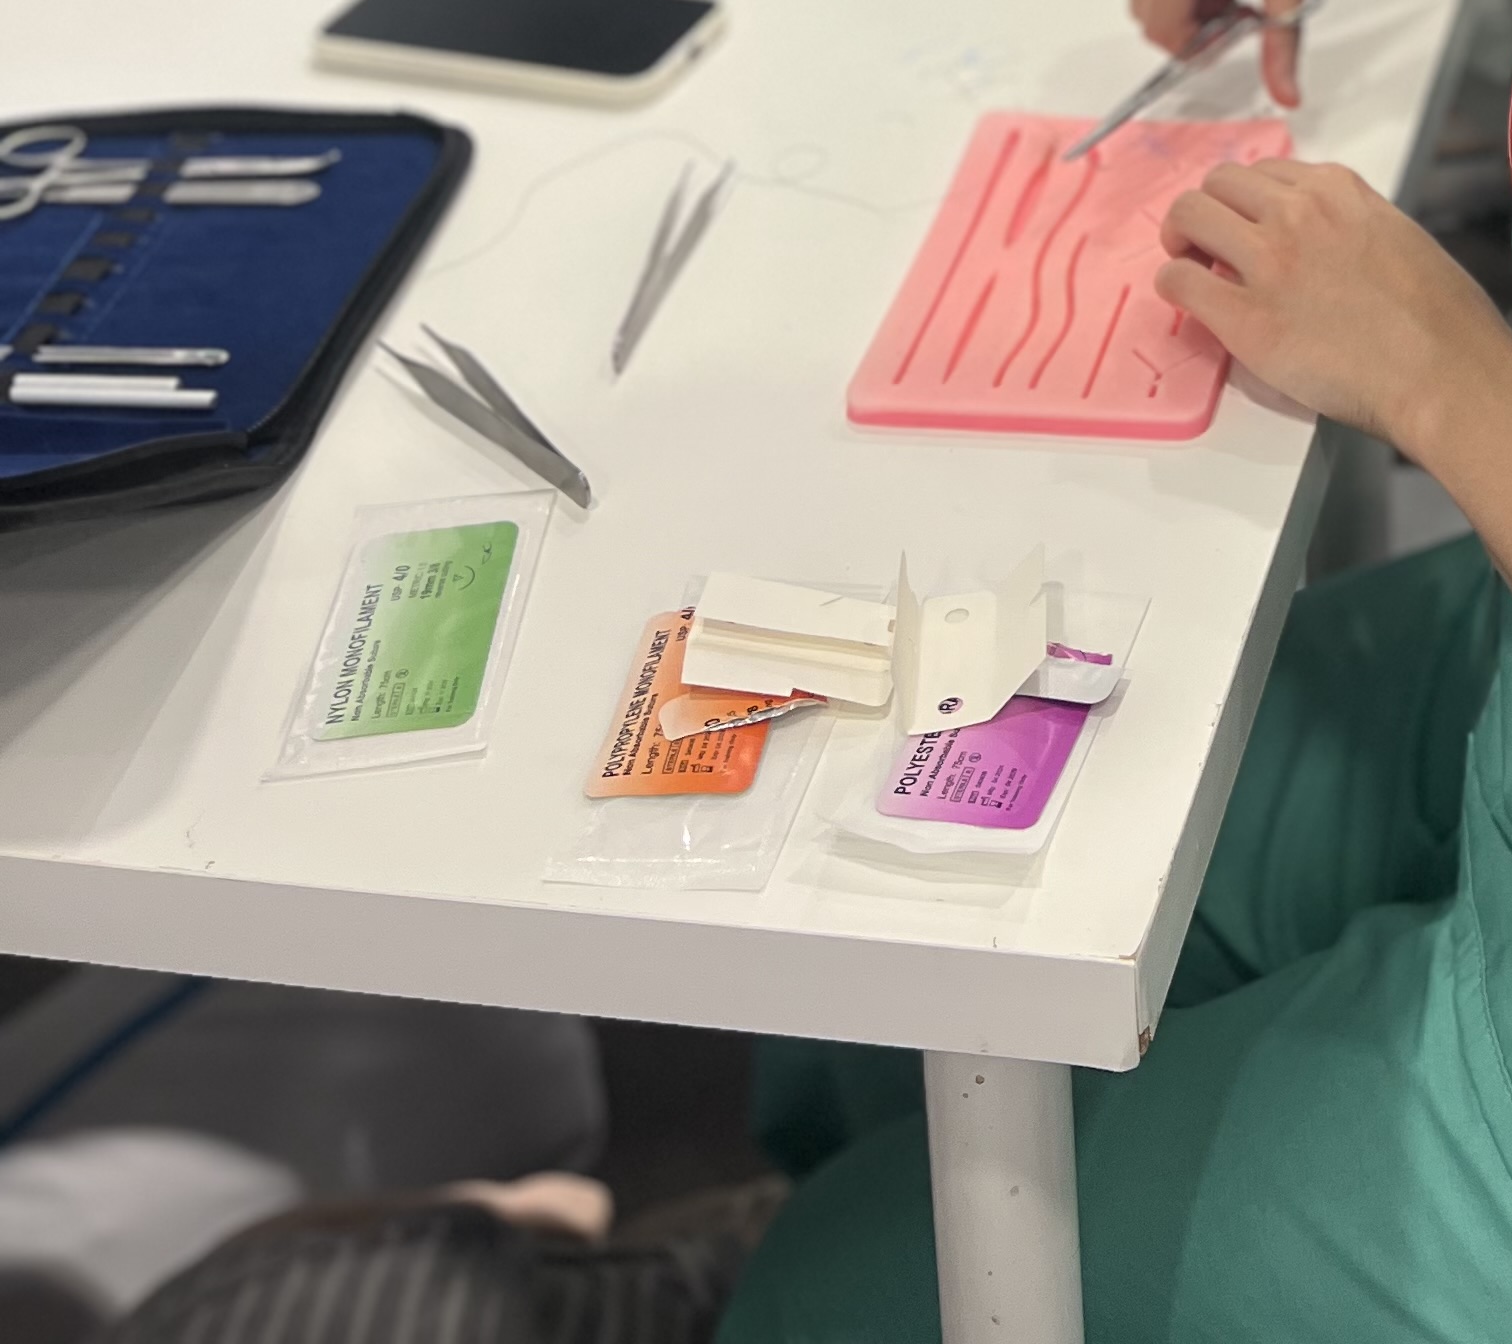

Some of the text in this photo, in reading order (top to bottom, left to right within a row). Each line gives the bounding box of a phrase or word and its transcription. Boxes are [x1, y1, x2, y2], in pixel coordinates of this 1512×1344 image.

[392, 565, 410, 581] 4/0
[326, 585, 381, 723] NYLON MONOFILAMENT
[603, 631, 669, 777] POLYPROPYLENE MONOFILAMENT
[622, 759, 635, 775] Non
[920, 781, 933, 796] Non
[929, 740, 954, 779] Absorbable
[951, 751, 966, 769] 75cm
